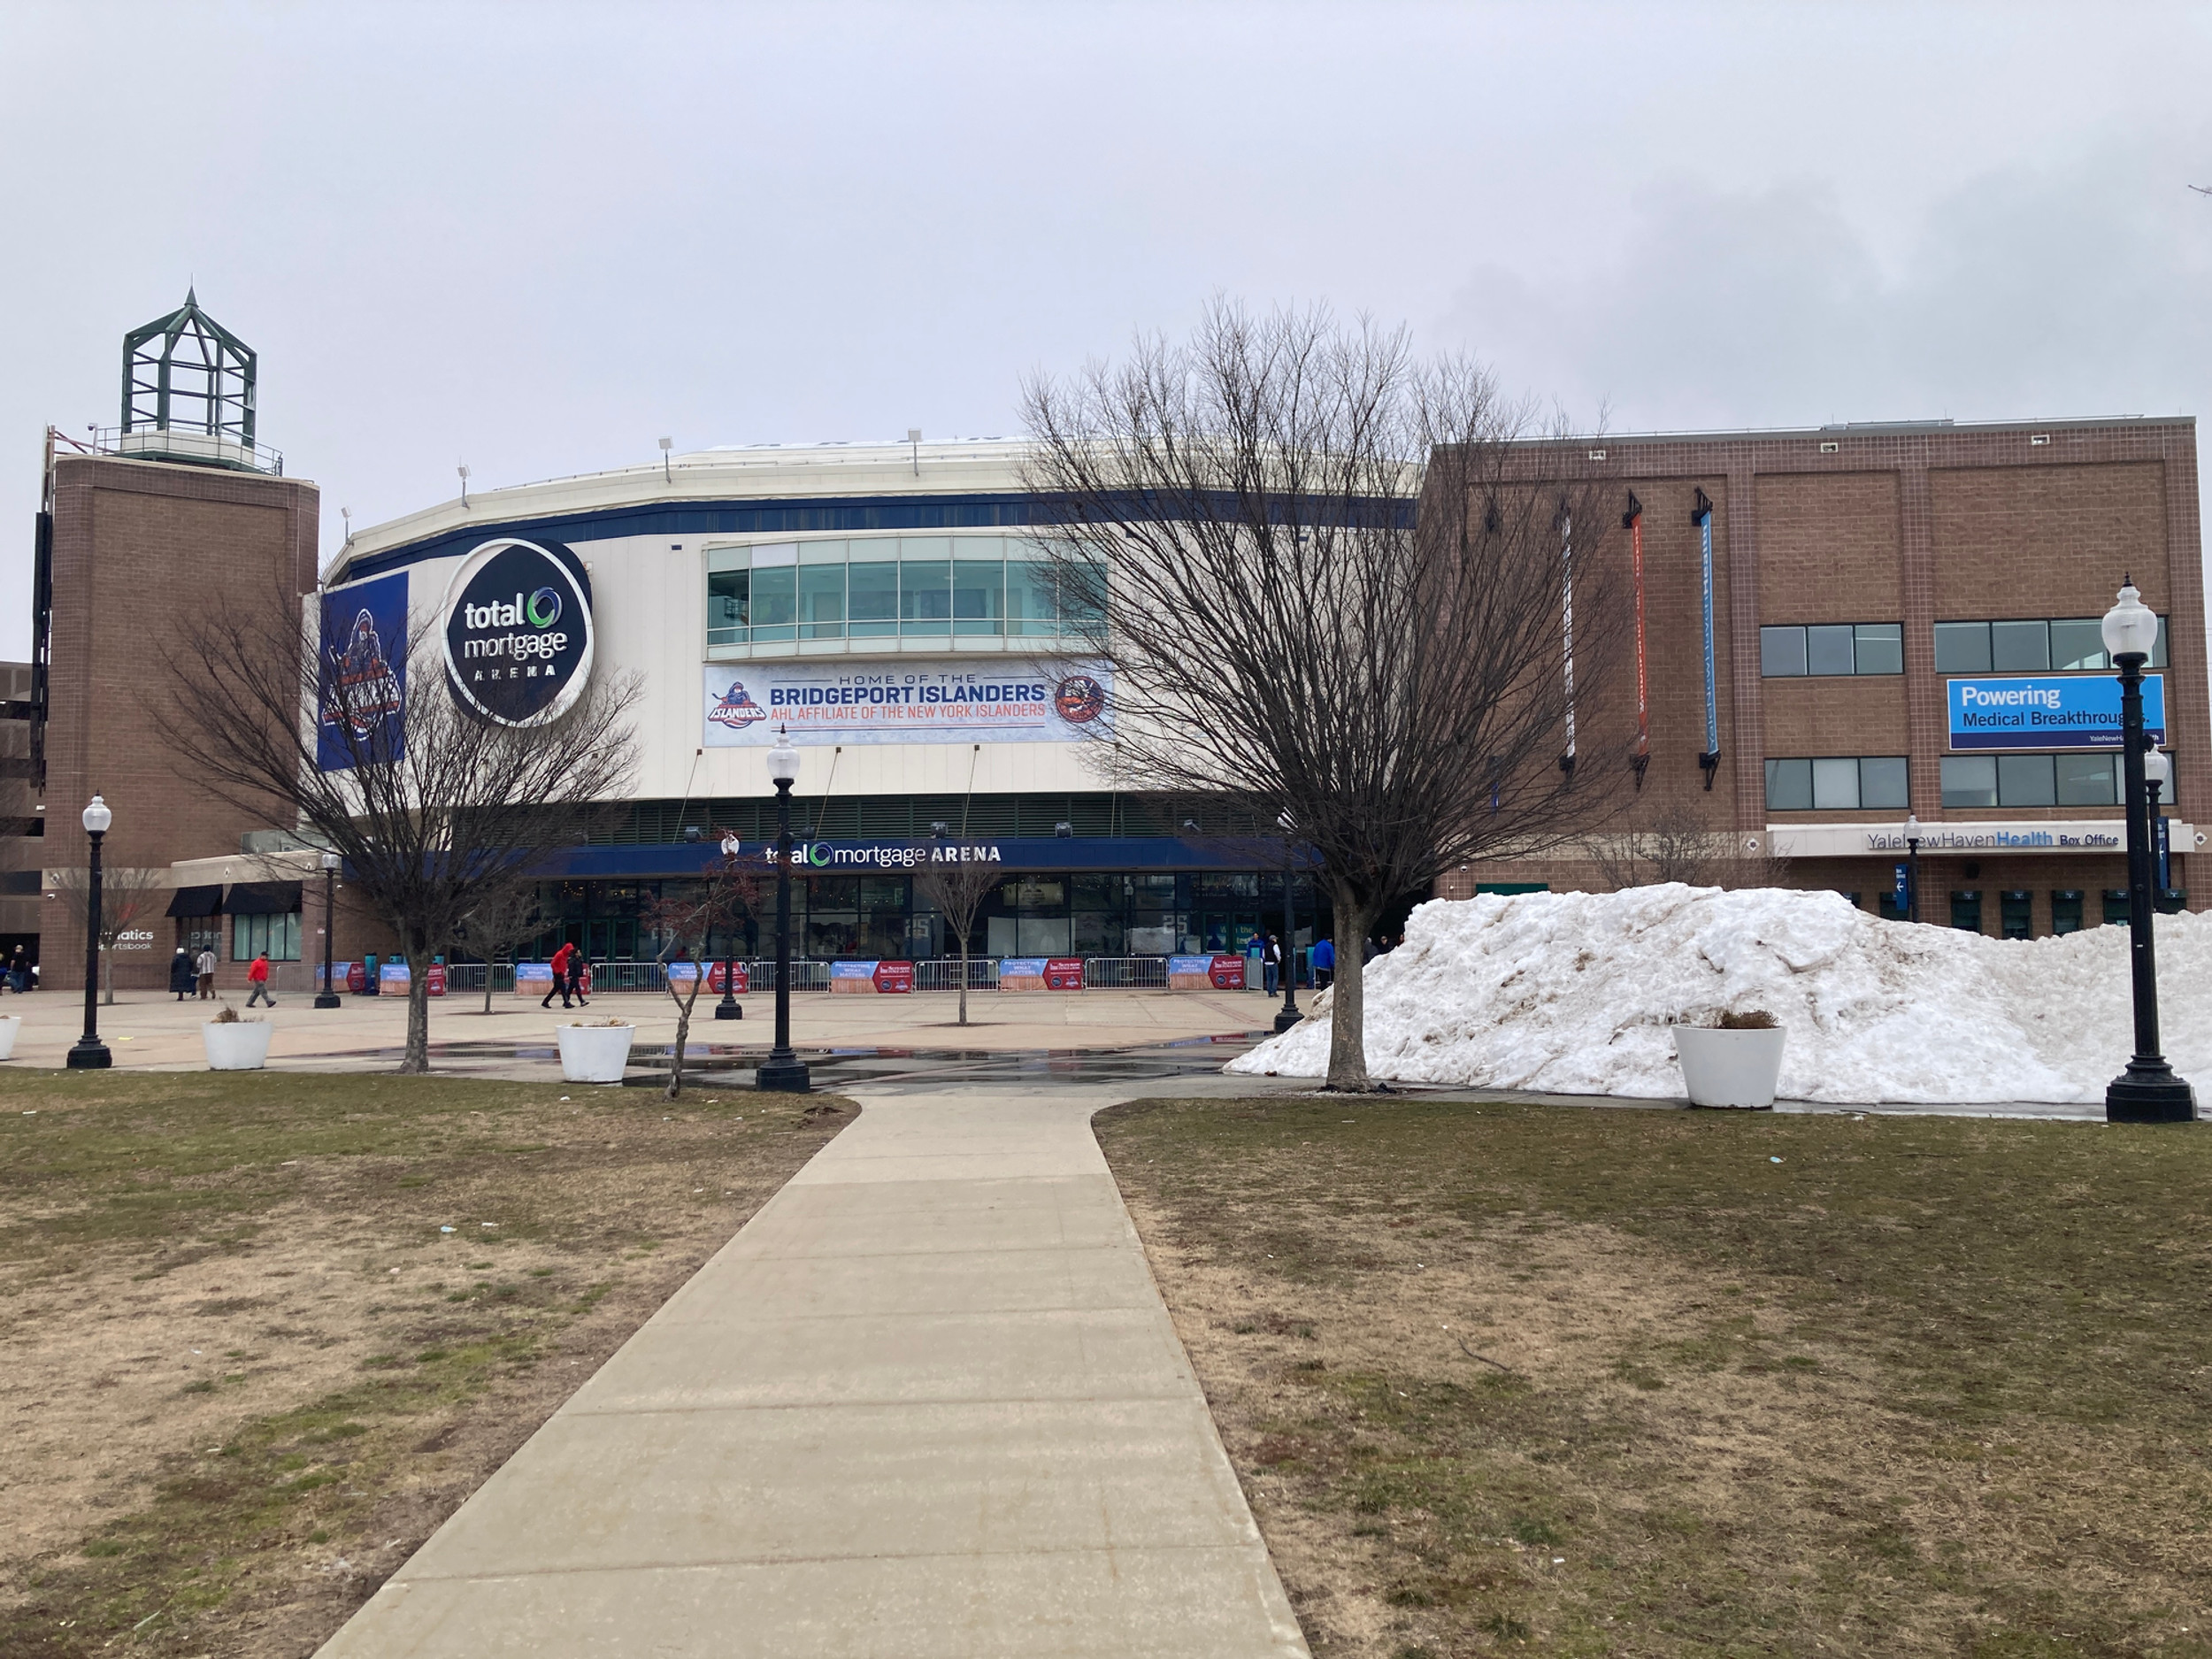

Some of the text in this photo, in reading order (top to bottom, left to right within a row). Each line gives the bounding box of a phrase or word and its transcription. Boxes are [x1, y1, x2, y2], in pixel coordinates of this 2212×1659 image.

[465, 592, 526, 629] total
[464, 632, 567, 661] mortgage
[474, 664, 557, 682] ARENA
[840, 673, 976, 686] HOME OF THE
[771, 684, 1046, 706] BRIDGEPORT ISLANDERS
[1962, 685, 2062, 709] Powering
[710, 707, 766, 718] ISLANDERS
[771, 708, 795, 721] AHL
[797, 706, 857, 720] AFFILIATE
[861, 706, 878, 719] OF
[881, 705, 903, 719] THE
[908, 705, 936, 718] NEW
[939, 704, 972, 718] YORK
[976, 703, 1046, 718] ISLANDERS
[1963, 710, 2149, 727] Medical Breakthroug.
[2060, 834, 2080, 846] Box
[2085, 833, 2119, 846] Office
[765, 843, 1002, 867] tal mortgage ARENA
